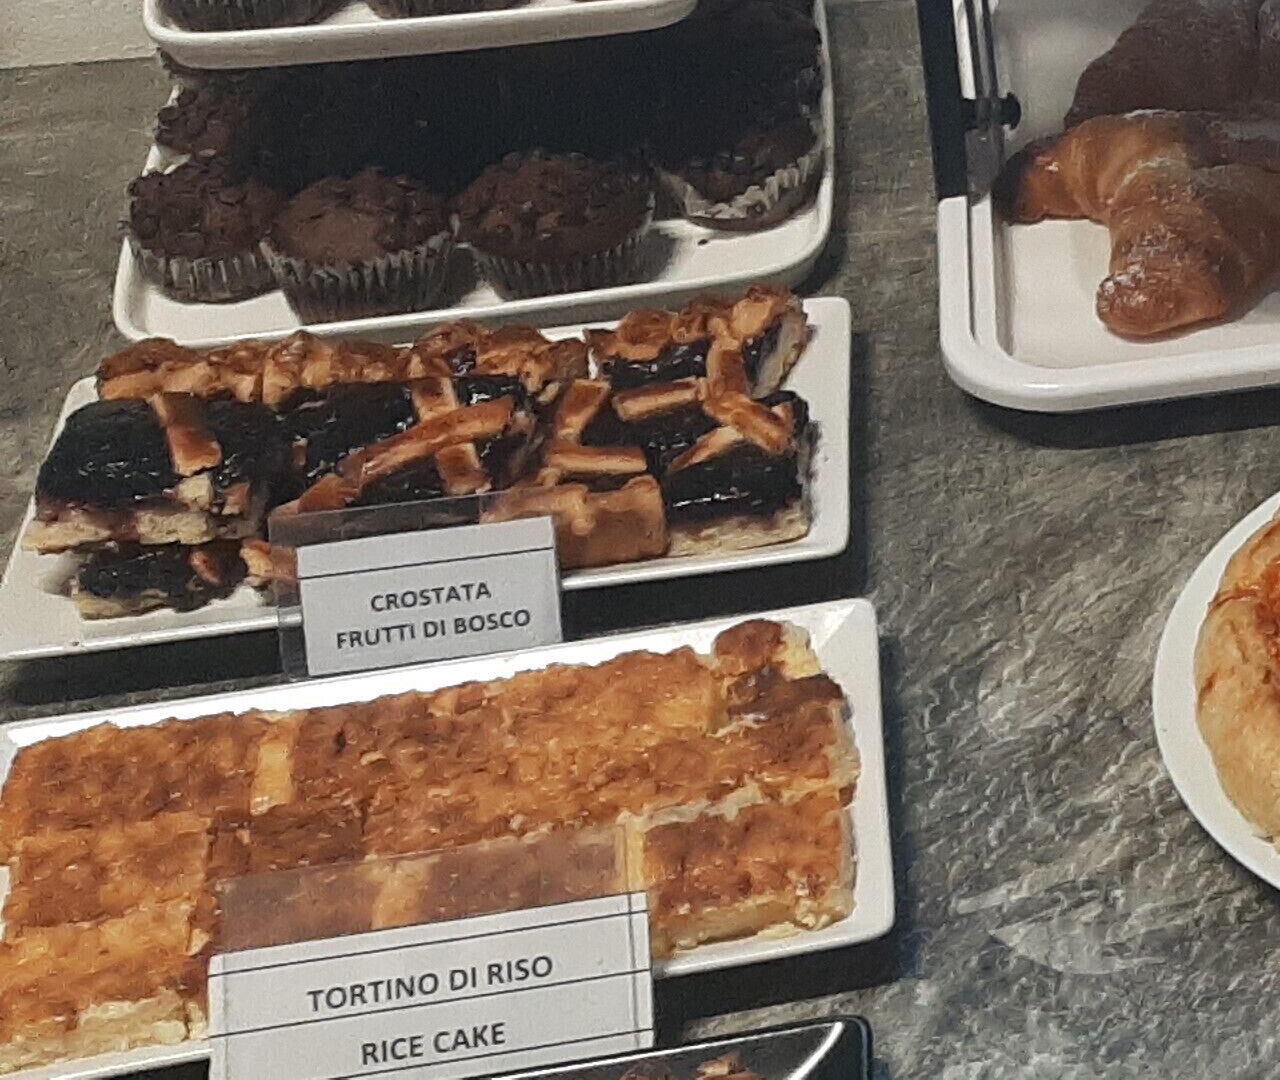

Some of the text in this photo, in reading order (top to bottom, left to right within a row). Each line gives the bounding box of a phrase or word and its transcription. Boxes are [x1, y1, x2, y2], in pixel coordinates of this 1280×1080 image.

[370, 581, 493, 613] CROSTATA
[335, 609, 532, 650] FRUTTI DI BOSCO
[306, 954, 554, 1013] TORTINO DI RISO
[361, 1021, 507, 1066] RICE CAKE
